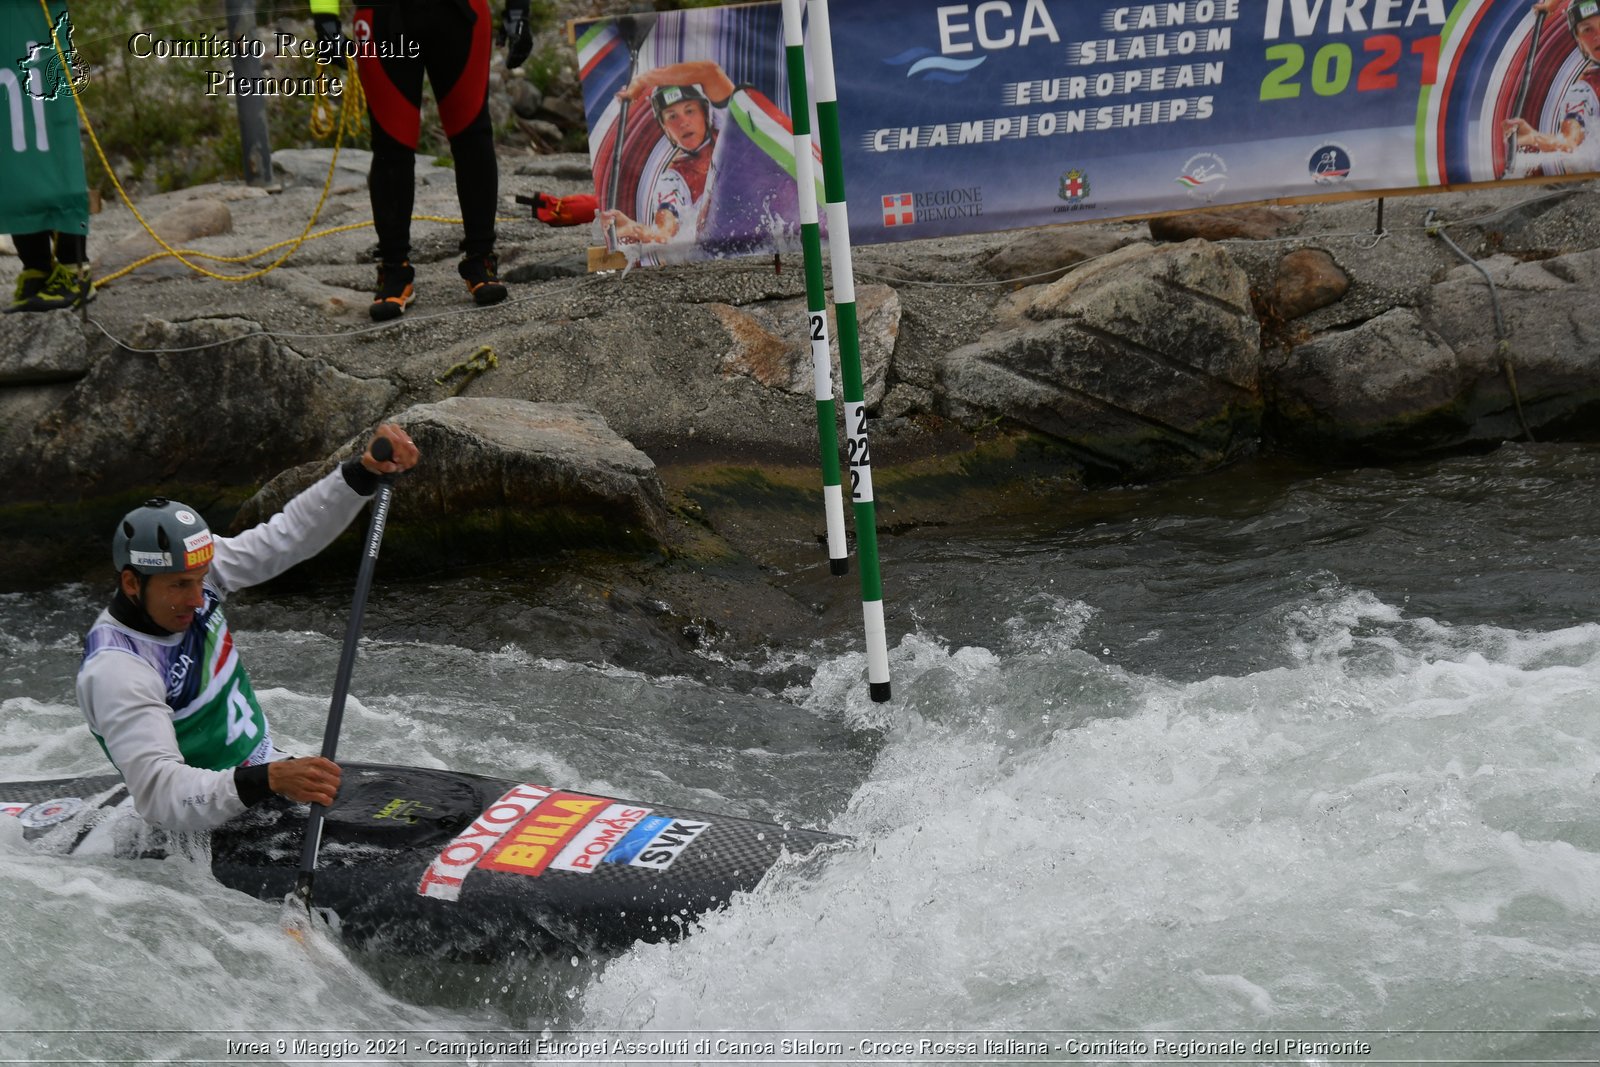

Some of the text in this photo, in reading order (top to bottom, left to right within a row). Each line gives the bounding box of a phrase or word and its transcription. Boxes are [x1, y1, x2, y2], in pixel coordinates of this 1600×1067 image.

[937, 0, 1061, 55] ECA
[1112, 0, 1240, 32] CANOE
[1263, 0, 1447, 41] IVREA
[1079, 27, 1232, 66] SLALOM
[1259, 34, 1442, 101] 2021
[1014, 61, 1225, 106] EUROPEAN
[872, 95, 1215, 152] CHAMPIONSHIPS
[914, 186, 984, 208] REGIONE
[915, 203, 984, 224] PIEMONTE
[809, 315, 825, 341] 2
[848, 437, 870, 467] 22
[225, 677, 259, 747] 4
[494, 799, 605, 869] BILLA
[639, 821, 705, 865] SVK
